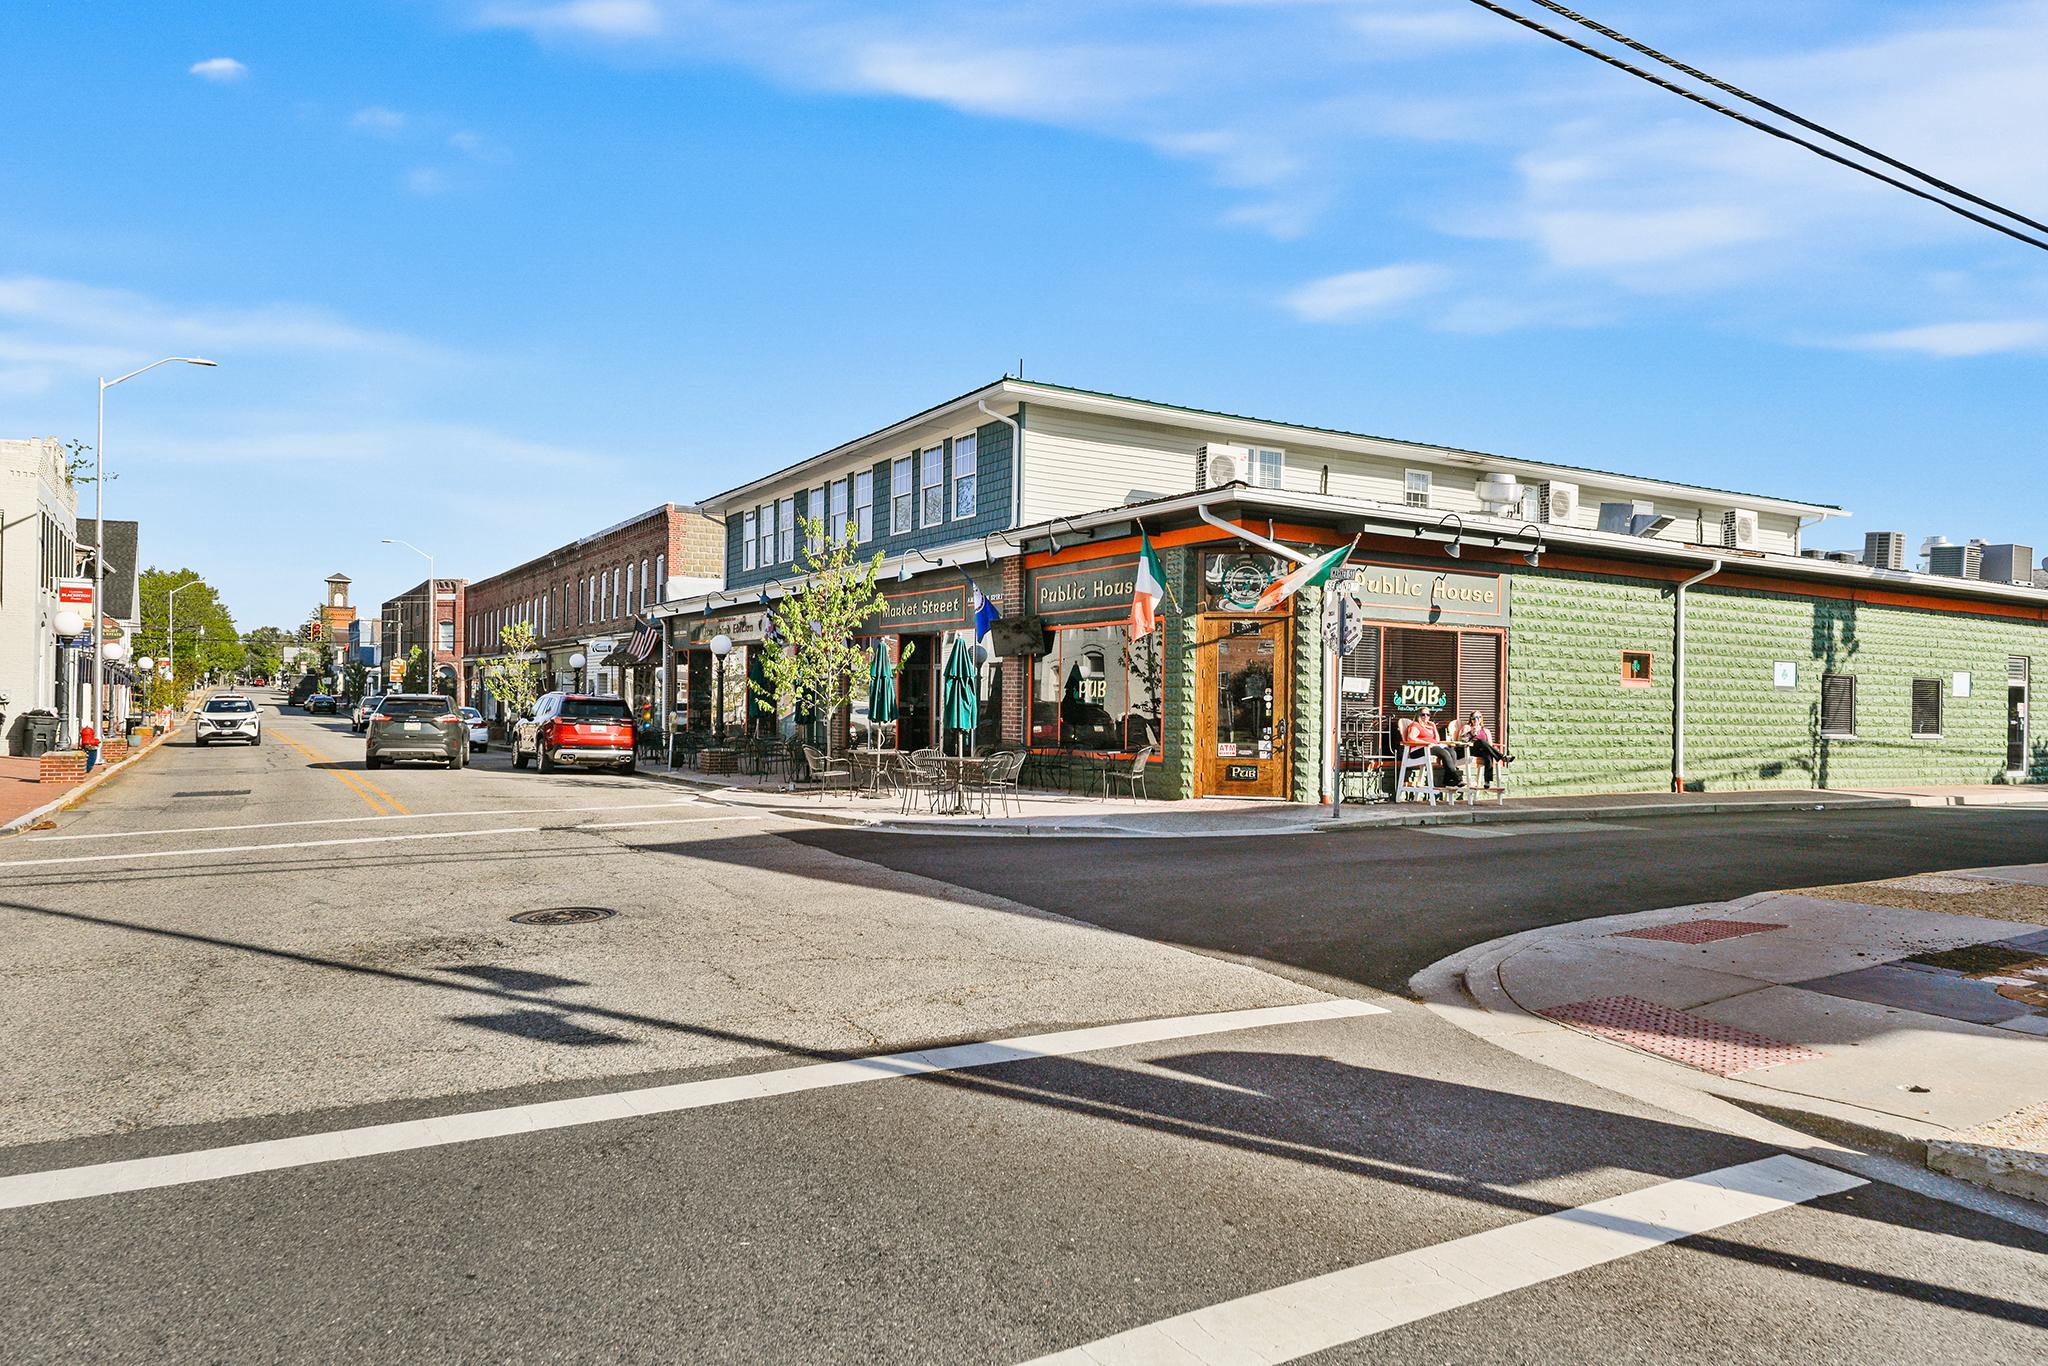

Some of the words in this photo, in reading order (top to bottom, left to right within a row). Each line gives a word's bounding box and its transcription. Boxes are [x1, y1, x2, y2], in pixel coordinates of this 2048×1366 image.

[1040, 581, 1087, 604] Public
[1092, 580, 1134, 598] Hous
[1432, 580, 1494, 603] House
[882, 602, 918, 618] Market
[922, 598, 959, 614] Street
[1219, 744, 1236, 752] ATM
